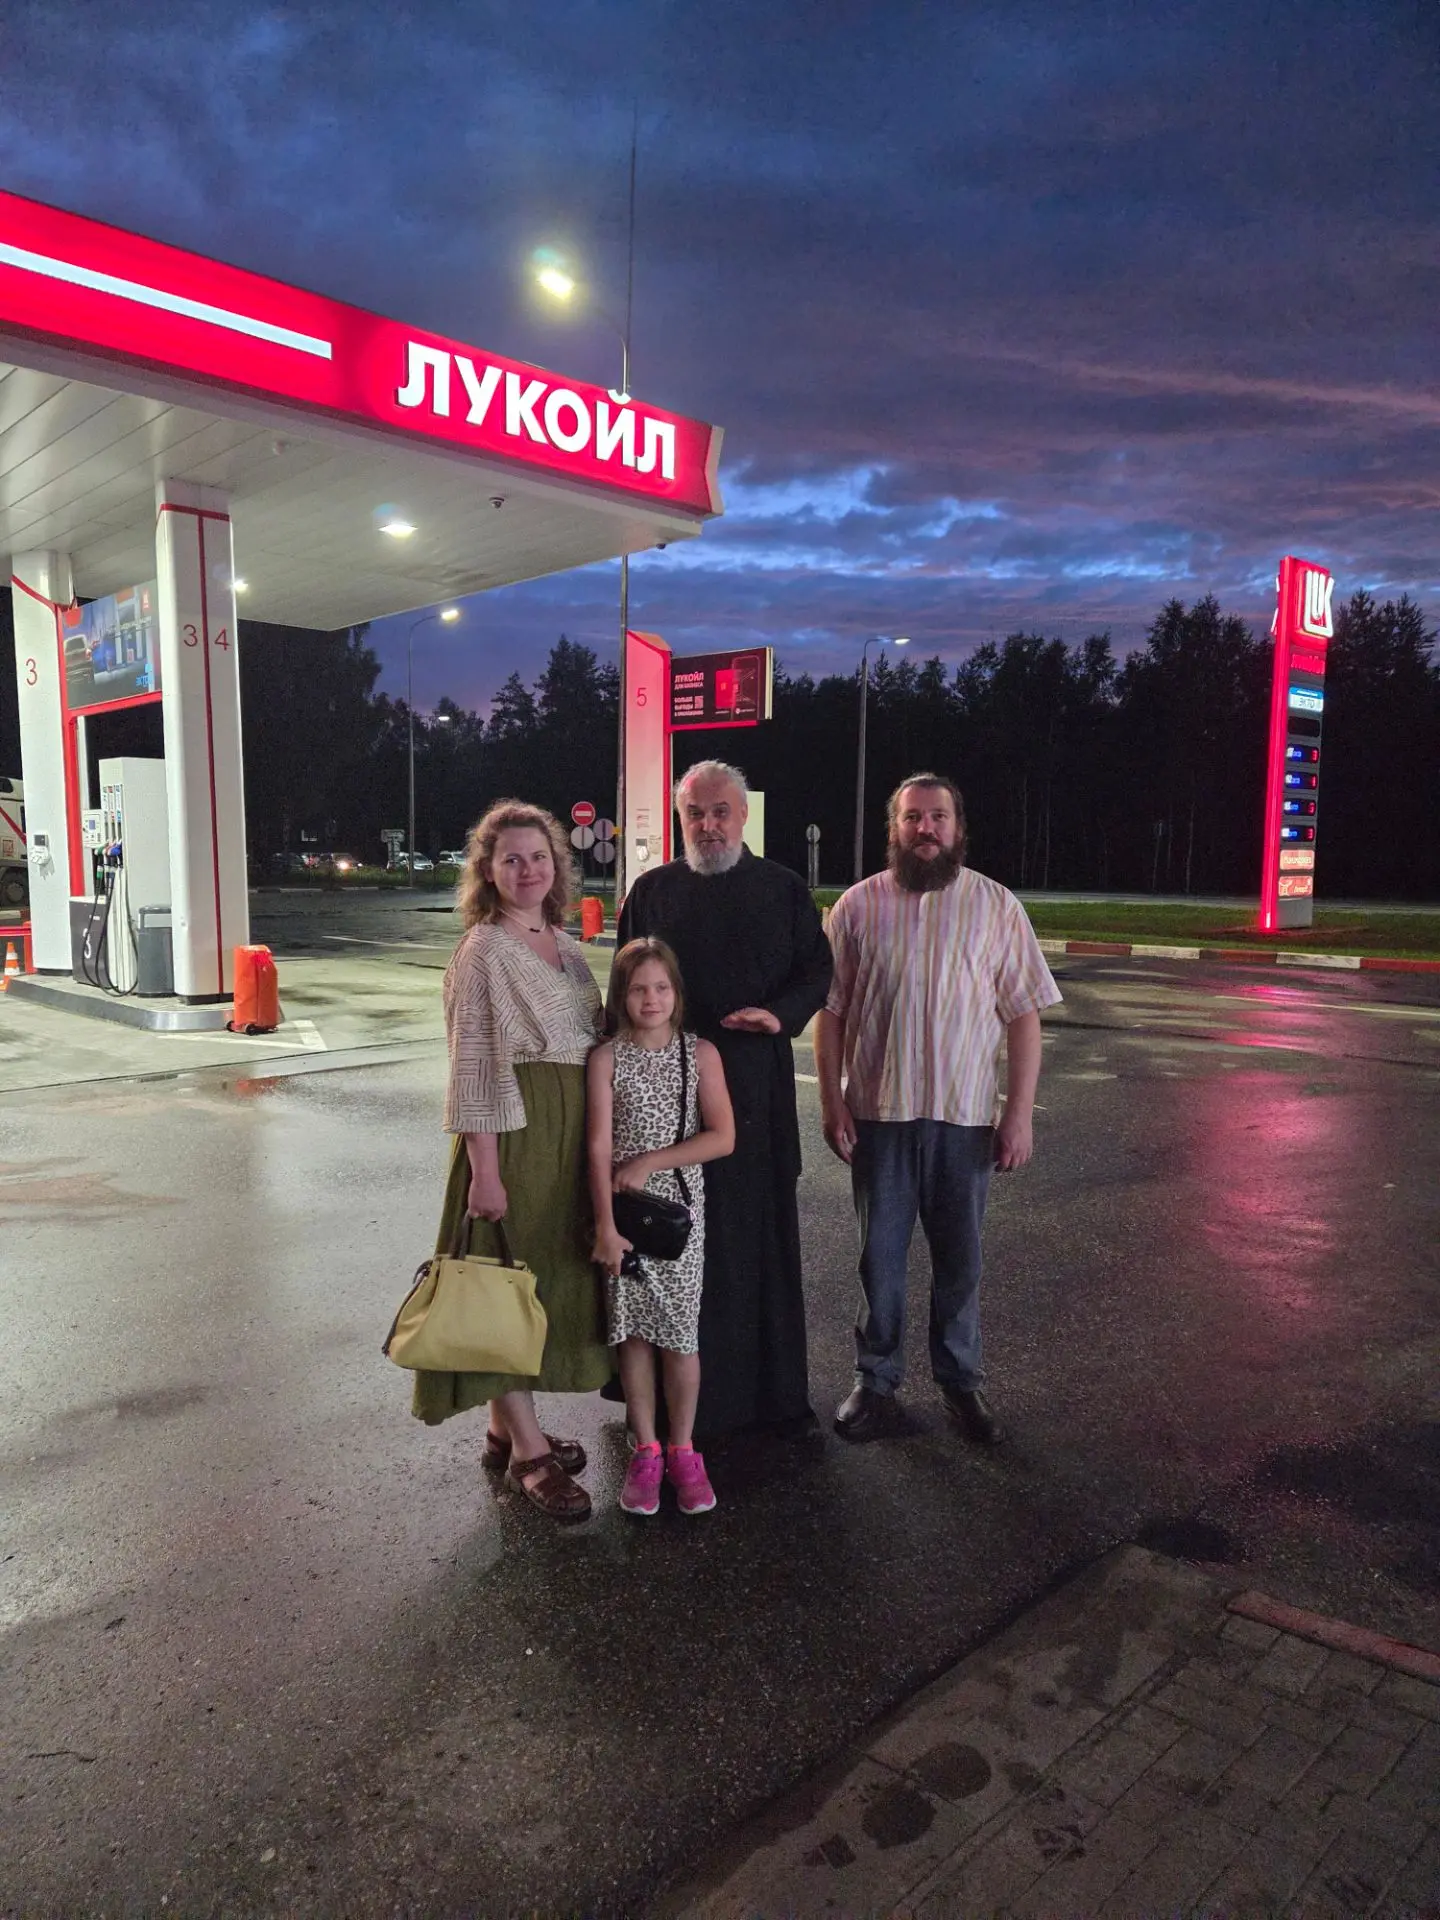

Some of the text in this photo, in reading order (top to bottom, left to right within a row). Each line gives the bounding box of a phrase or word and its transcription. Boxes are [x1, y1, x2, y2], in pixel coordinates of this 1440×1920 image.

[397, 341, 676, 480] ЛУКОЙЛ
[183, 624, 199, 648] 3
[214, 628, 231, 651] 4
[25, 658, 38, 686] 3
[674, 671, 704, 683] ЛУКОЙЛ
[636, 687, 648, 707] 5
[83, 928, 91, 959] 3
